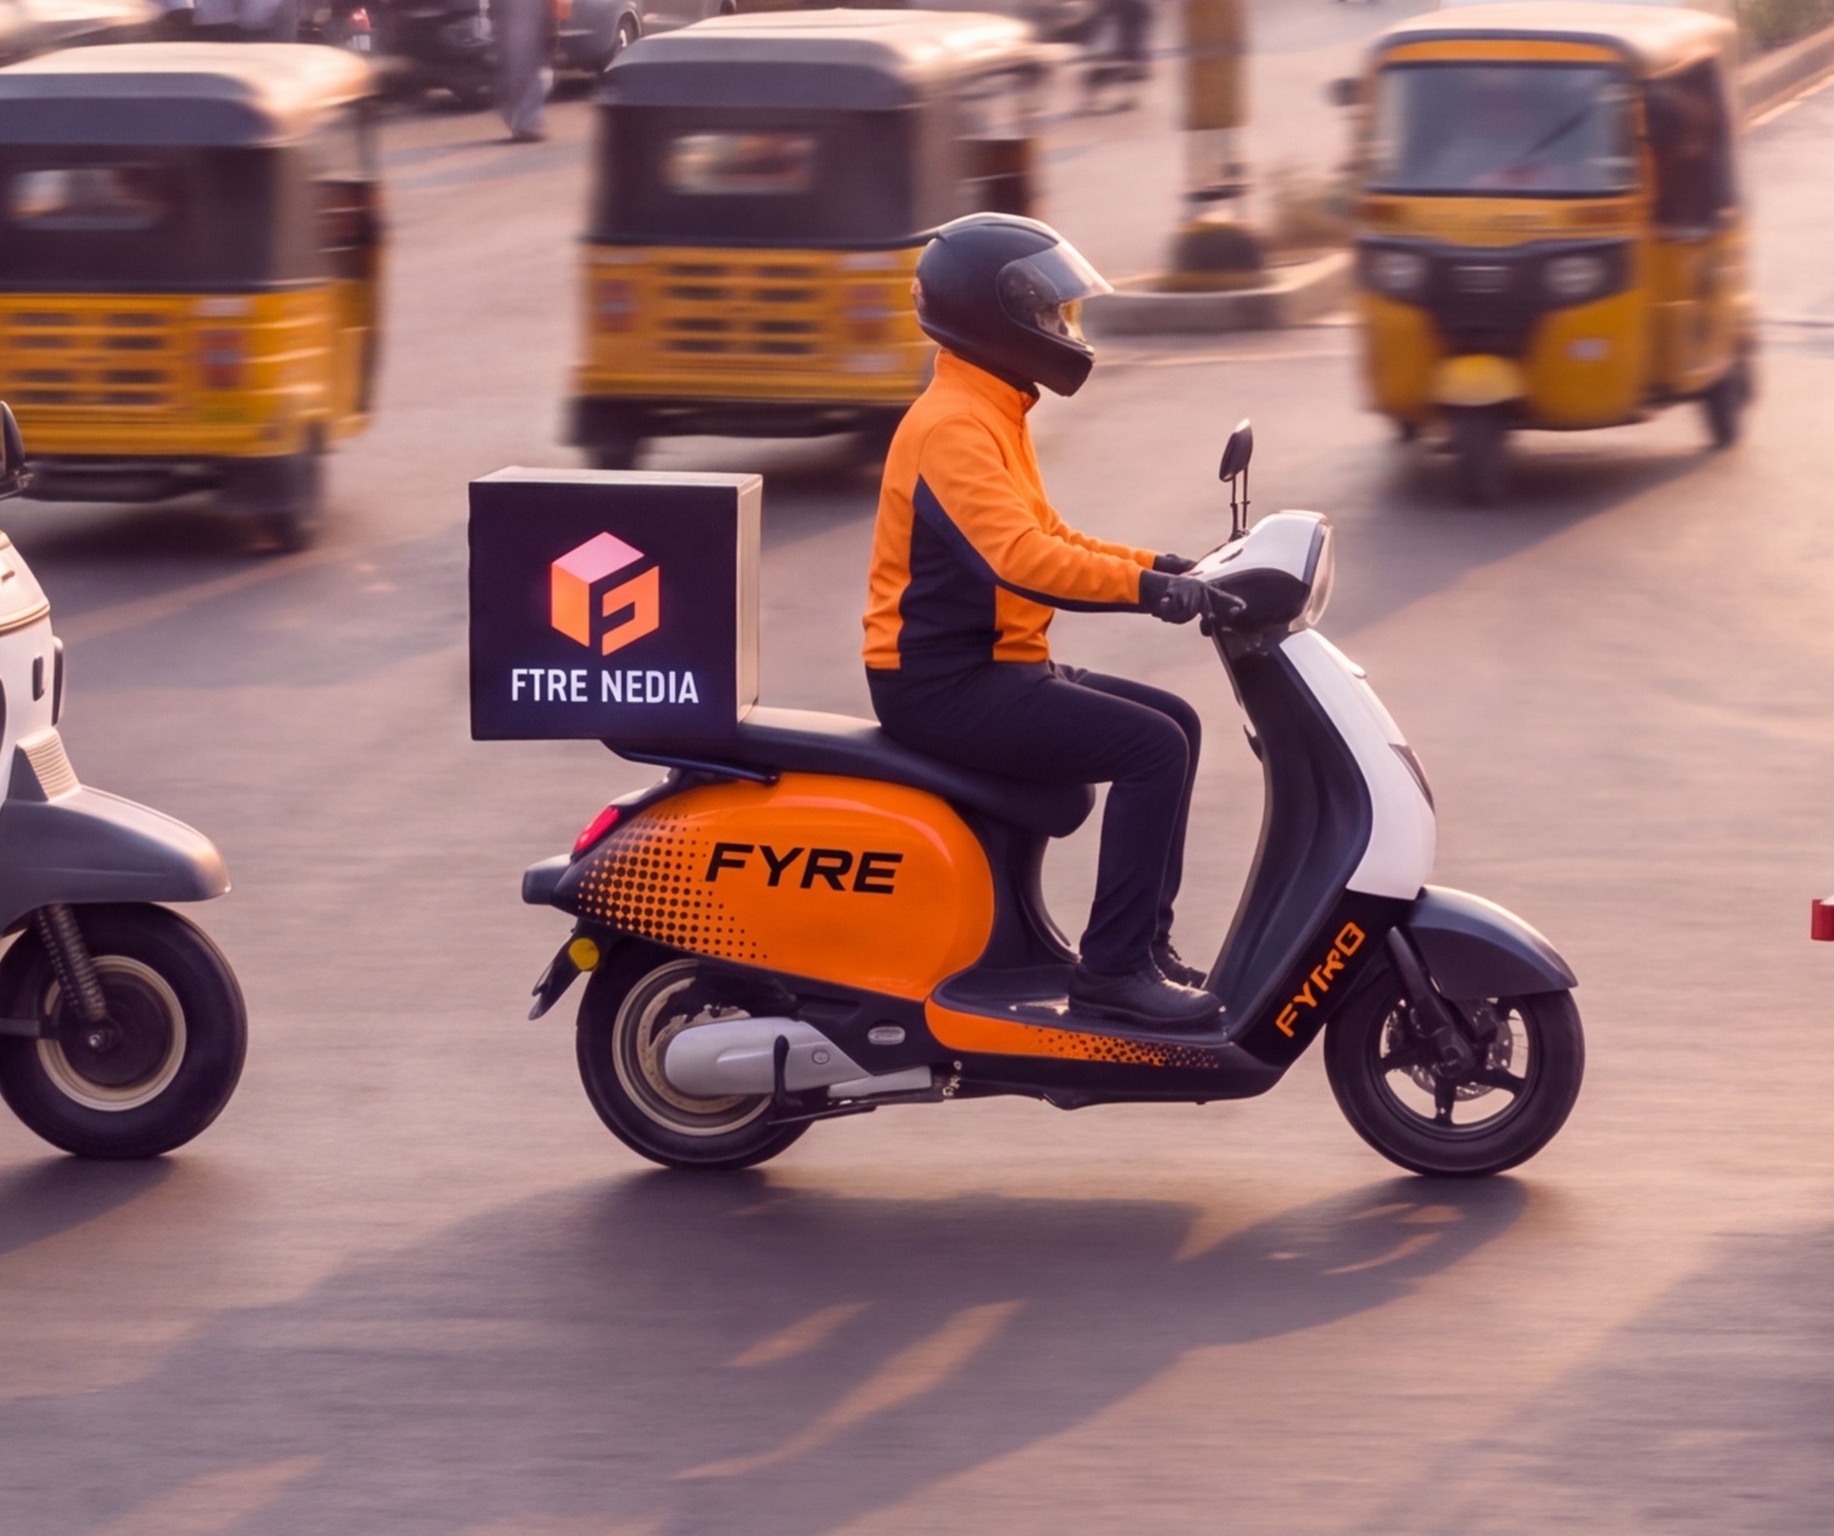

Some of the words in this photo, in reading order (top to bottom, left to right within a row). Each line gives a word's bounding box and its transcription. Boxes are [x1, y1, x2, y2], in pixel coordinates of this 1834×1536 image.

[511, 668, 589, 702] FTRE
[601, 670, 700, 704] NEDIA
[705, 842, 904, 895] FYRE
